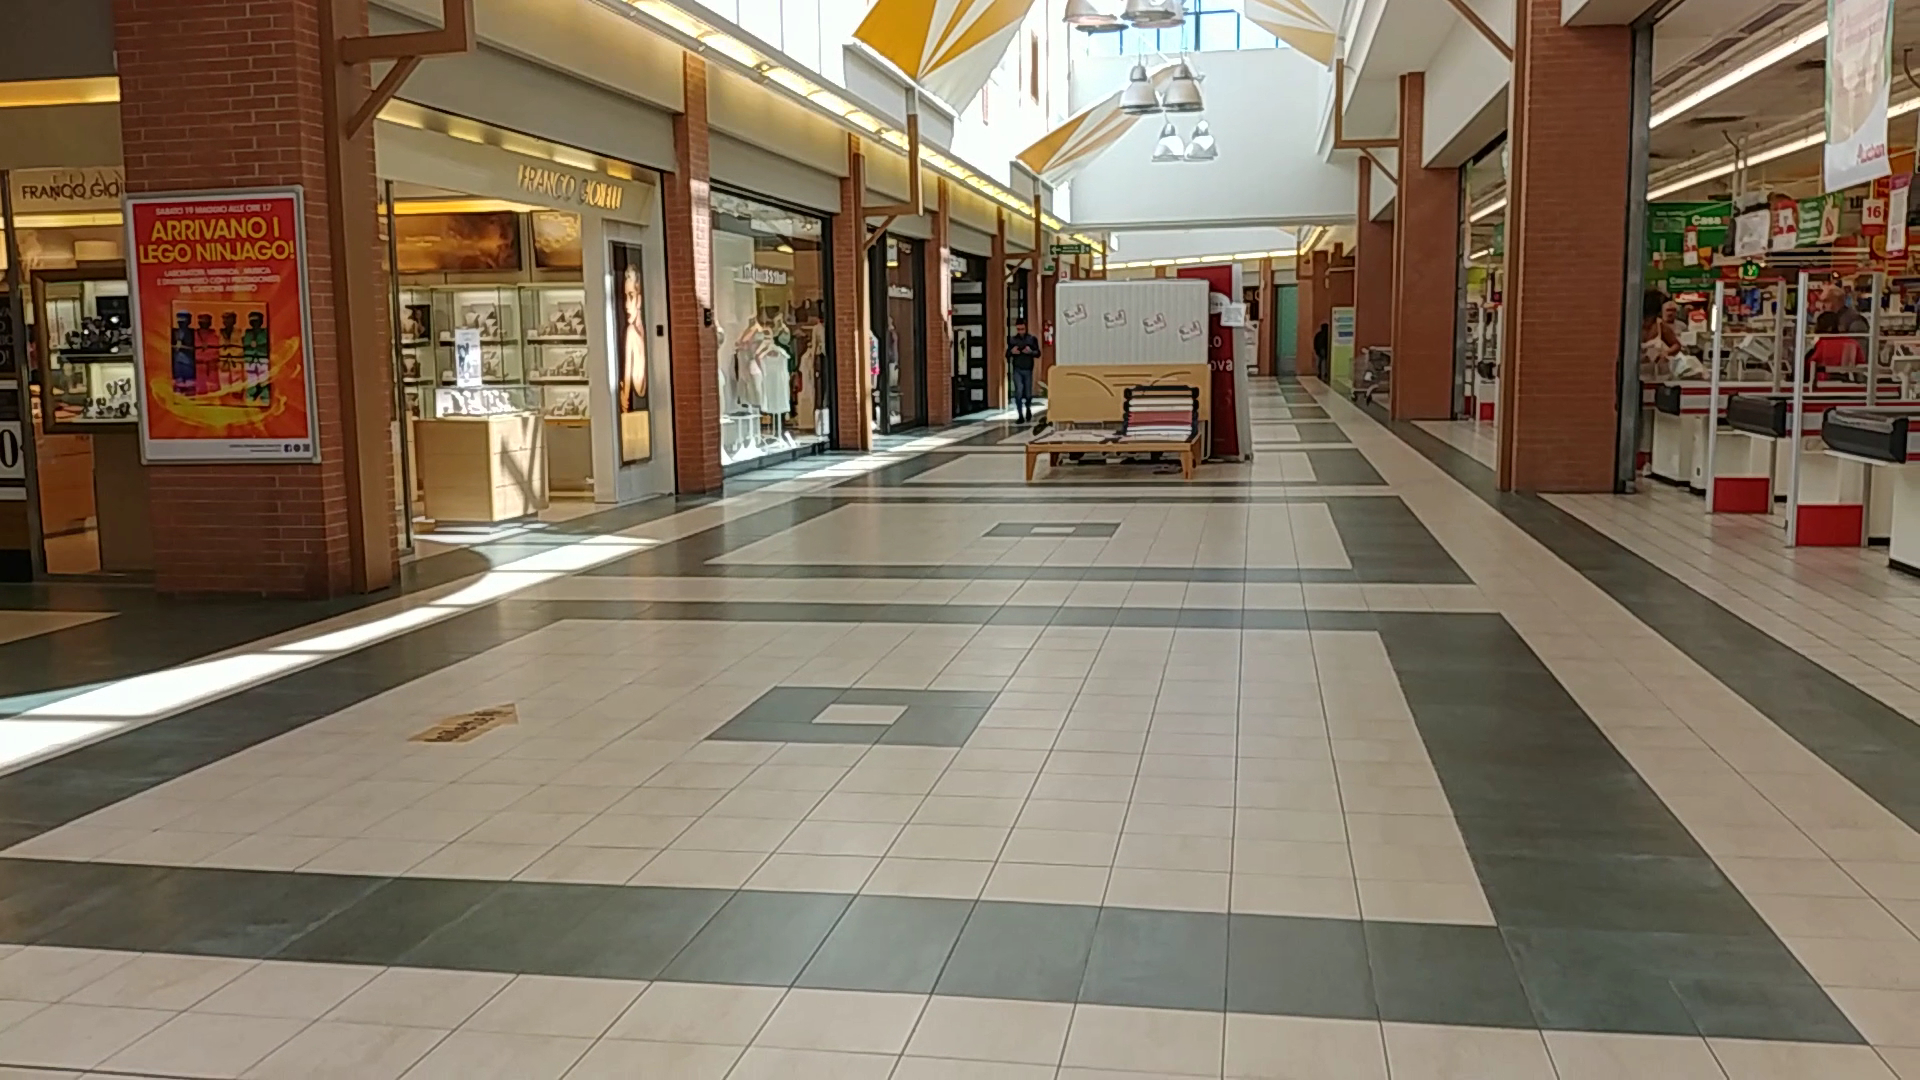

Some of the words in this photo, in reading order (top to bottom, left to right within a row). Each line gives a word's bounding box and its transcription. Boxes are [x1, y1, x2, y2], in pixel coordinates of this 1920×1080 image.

[21, 183, 87, 199] FRANCO
[517, 164, 577, 201] FRANCO
[1691, 215, 1722, 226] Casa
[1866, 205, 1882, 219] 16
[151, 216, 268, 242] ARRIVANO
[272, 215, 280, 238] I
[139, 243, 192, 264] LEGO
[196, 240, 295, 263] NINJAGO!
